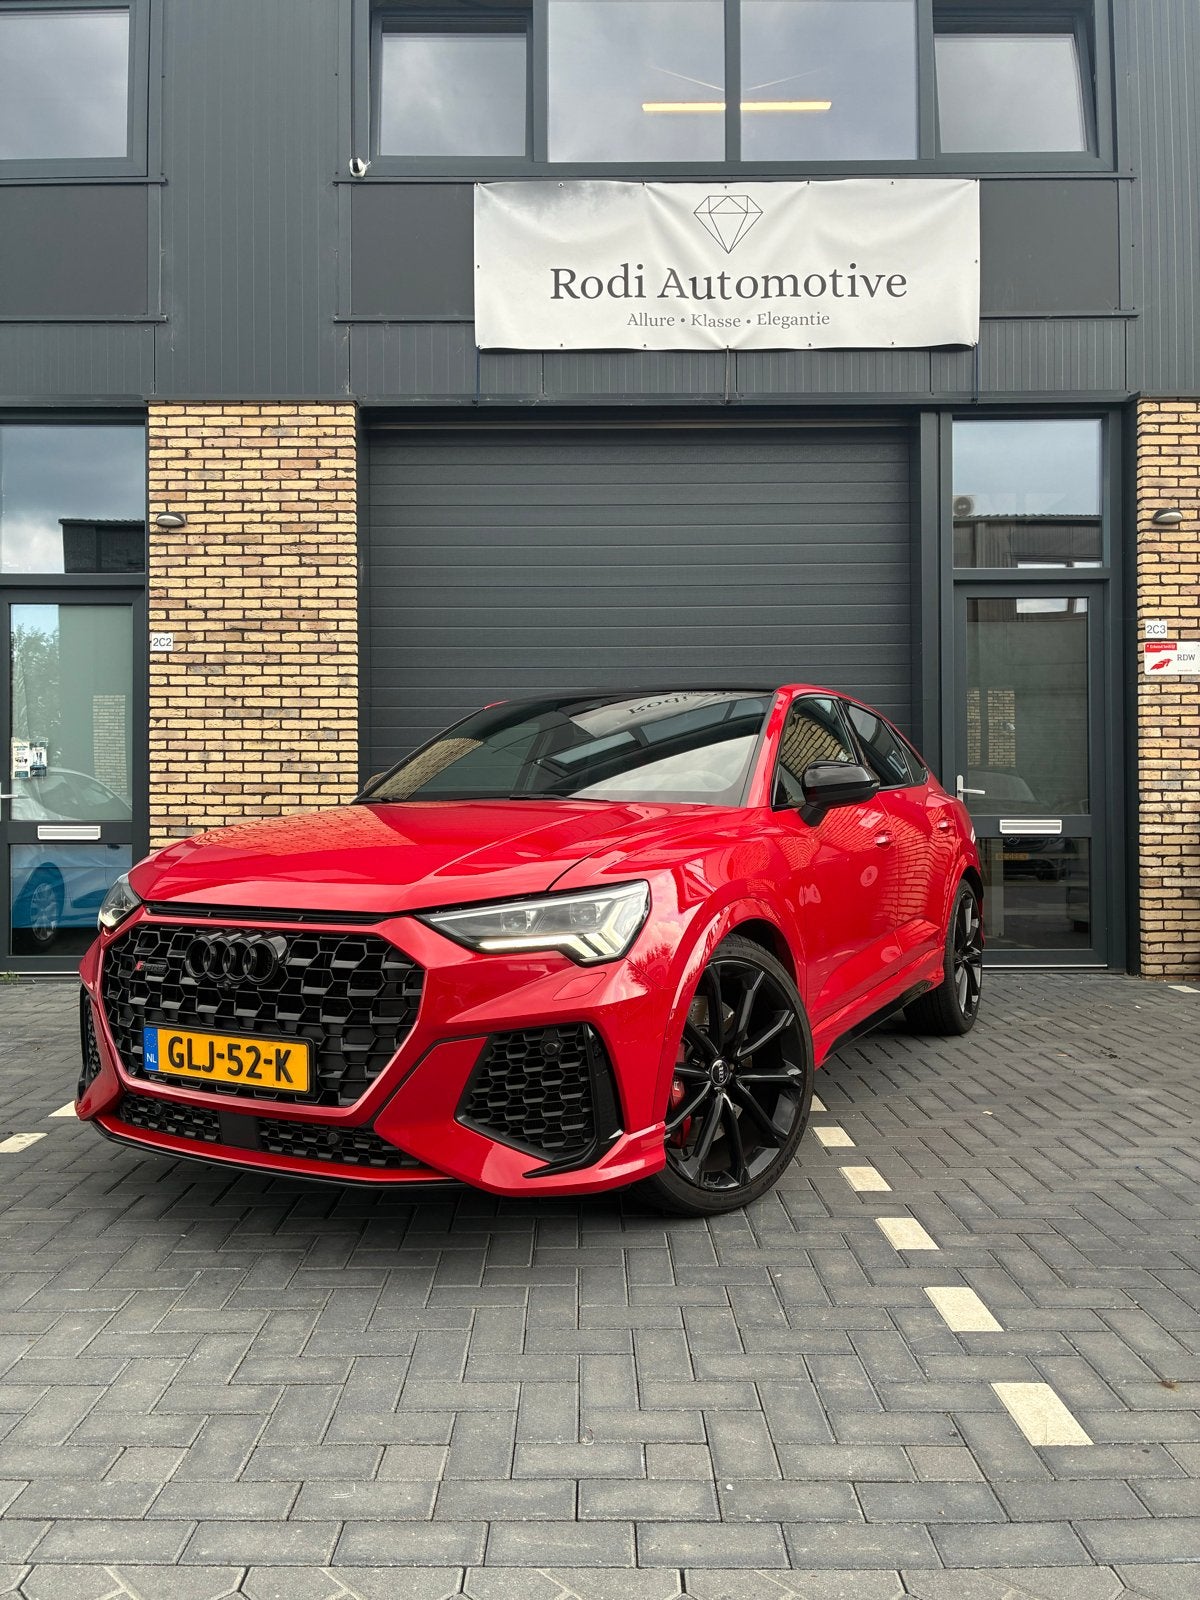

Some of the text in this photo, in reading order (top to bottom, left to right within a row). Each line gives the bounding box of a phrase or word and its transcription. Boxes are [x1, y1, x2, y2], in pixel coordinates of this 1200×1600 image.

[550, 262, 908, 301] Rodi Automotive
[626, 311, 831, 330] Allure Klasse Elegantie
[1146, 624, 1166, 634] 2C3
[153, 637, 172, 647] 2C2
[1176, 653, 1196, 661] RDW
[146, 1035, 294, 1084] NL GLJ-52-K
